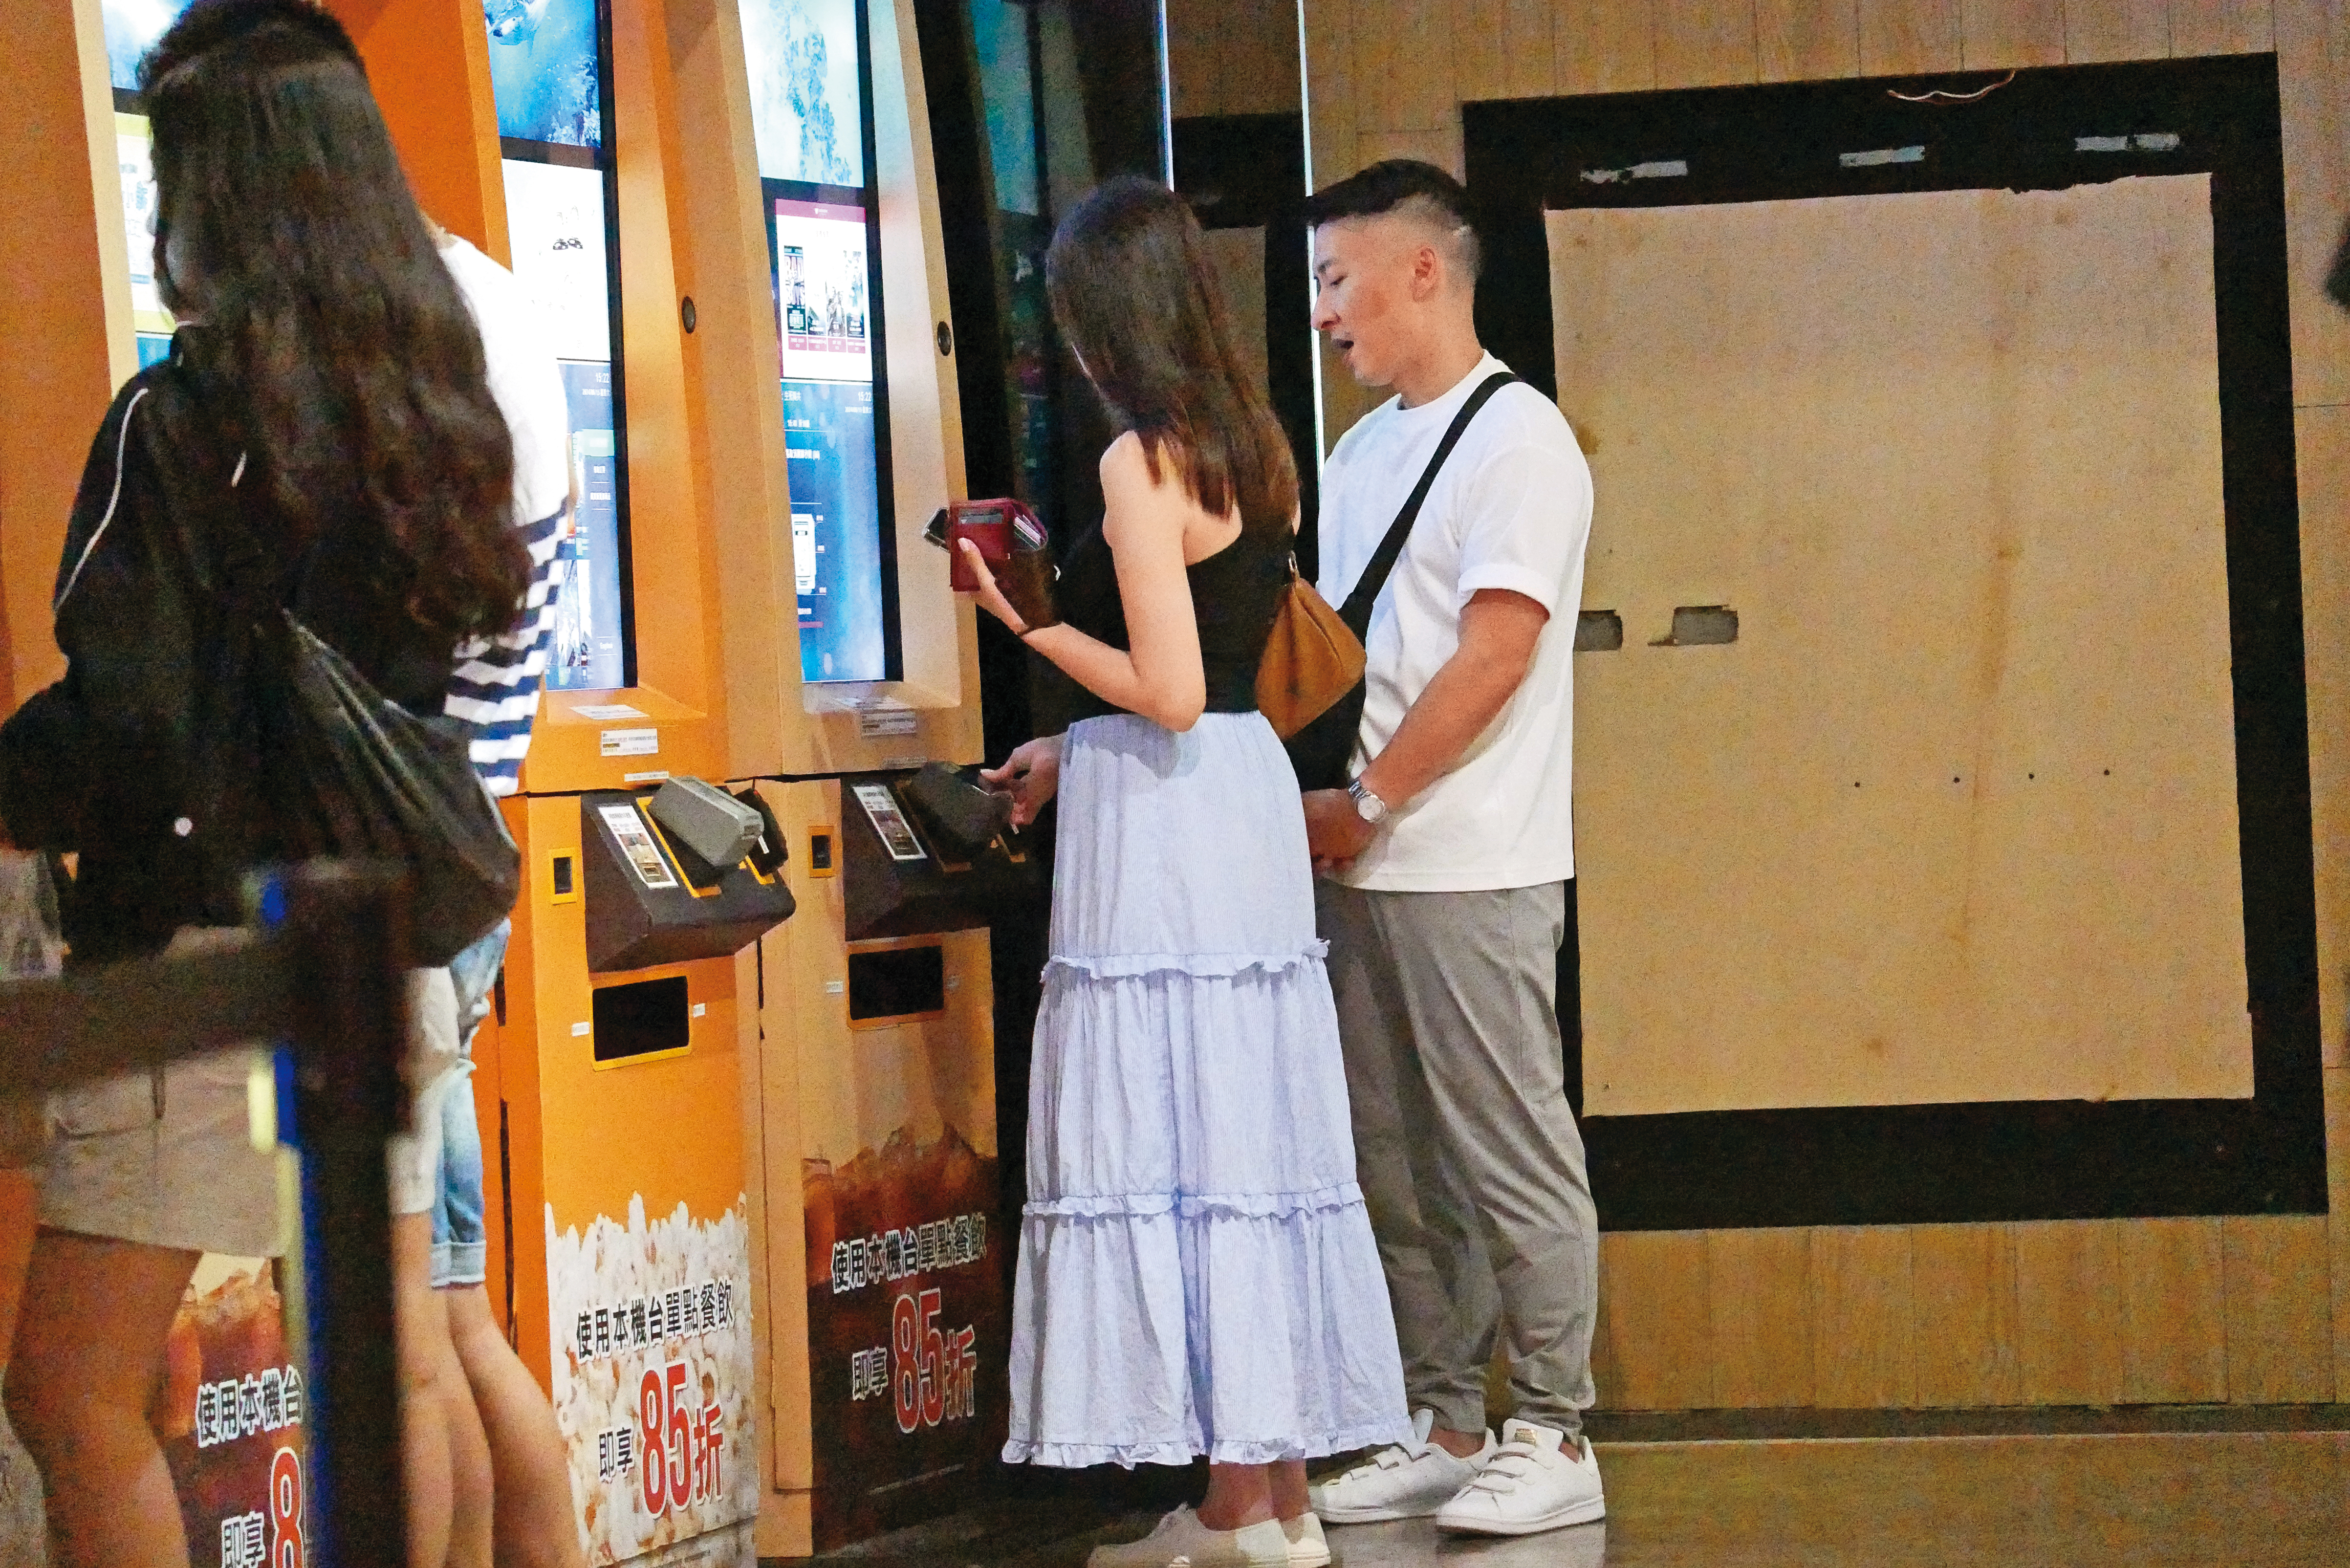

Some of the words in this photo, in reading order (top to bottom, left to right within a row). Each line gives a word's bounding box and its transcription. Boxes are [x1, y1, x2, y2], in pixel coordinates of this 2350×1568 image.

[596, 373, 610, 383] 15:22
[858, 391, 872, 401] 15:22
[831, 1212, 987, 1293] 使用本機台單點餐飲
[576, 1277, 733, 1360] 使用本機台單點餐飲
